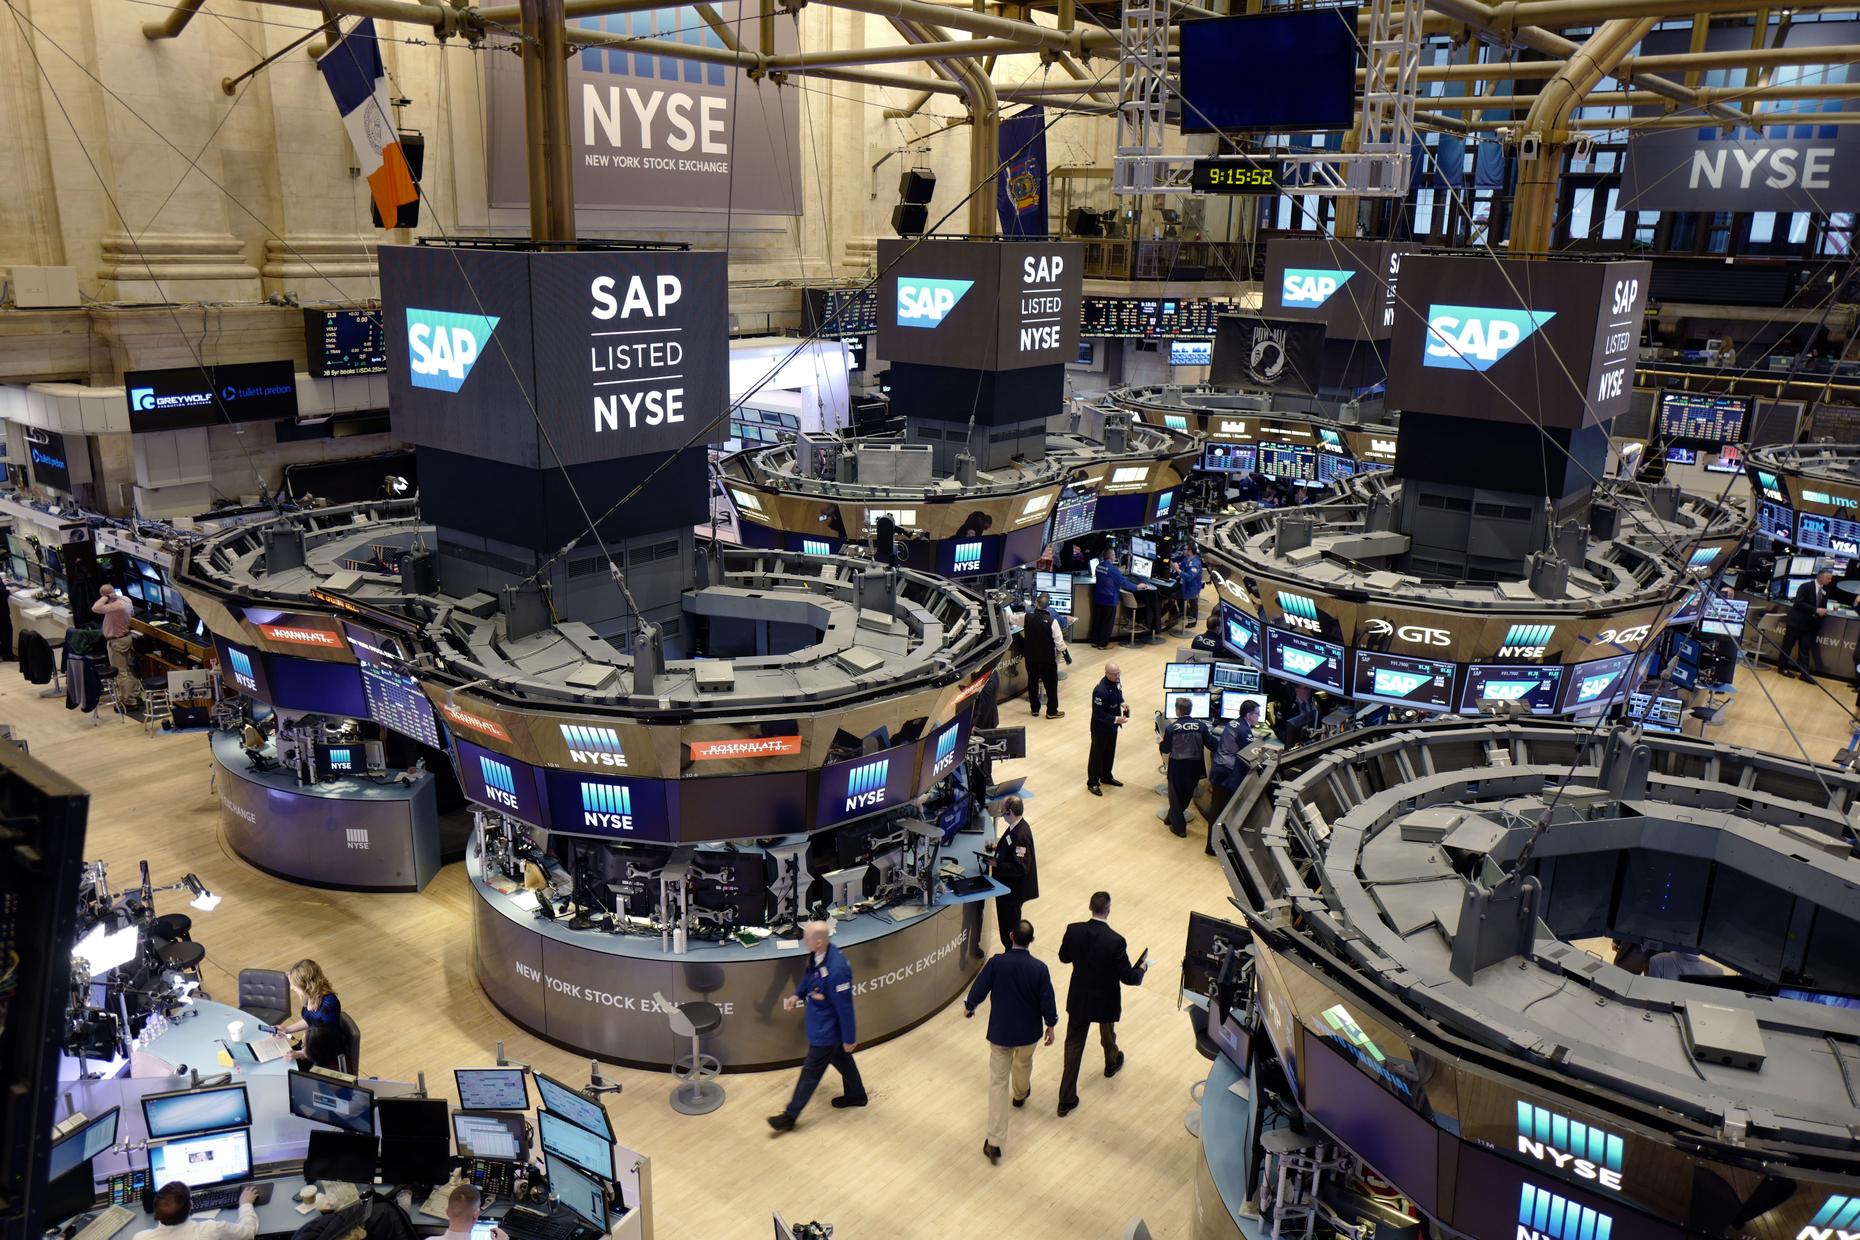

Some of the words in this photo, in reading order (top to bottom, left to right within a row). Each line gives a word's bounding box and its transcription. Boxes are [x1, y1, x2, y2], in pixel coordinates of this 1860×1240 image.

[583, 84, 728, 154] NYSE
[585, 155, 609, 167] NEW
[613, 156, 640, 168] YORK
[644, 158, 676, 170] STOCK
[679, 160, 728, 173] EXCHANGE
[1689, 148, 1835, 189] NYSE
[1210, 169, 1273, 185] 9:15:52
[1023, 256, 1064, 283] SAP
[591, 275, 682, 320] SAP
[1284, 275, 1337, 302] SAP
[1612, 279, 1638, 315] SAP
[898, 285, 954, 320] SAP
[1021, 297, 1062, 315] LISTED
[1020, 326, 1060, 351] NYSE
[1426, 316, 1520, 361] SAP
[1605, 332, 1630, 356] LISTED
[409, 322, 477, 379] SAP
[592, 341, 683, 372] LISTED
[1598, 368, 1625, 402] NYSE
[157, 393, 212, 405] GREYWOLF
[593, 388, 684, 432] NYSE
[1832, 497, 1858, 509] imc
[1803, 520, 1825, 532] IBM
[1831, 540, 1858, 554] VISA
[953, 560, 980, 572] NYSE
[1284, 612, 1322, 633] NYSE
[1398, 625, 1451, 646] GTS
[1616, 625, 1652, 643] GTS
[1816, 635, 1840, 648] NEW
[1843, 640, 1857, 651] YO
[1284, 650, 1316, 672] SAP
[1498, 646, 1546, 657] NYSE
[235, 671, 257, 692] NYSE
[1376, 673, 1418, 694] SAP
[1484, 685, 1525, 699] SAP
[1580, 677, 1610, 698] SAP
[1182, 722, 1199, 731] GTS
[710, 741, 783, 753] ROSENBLATT
[331, 762, 352, 770] NYSE
[569, 749, 628, 767] NYSE
[933, 750, 955, 777] NYSE
[486, 784, 519, 810] NYSE
[845, 788, 886, 812] NYSE
[584, 812, 633, 830] NYSE
[347, 842, 369, 850] NYSE
[850, 982, 867, 996] RK
[870, 963, 914, 991] STOCK
[915, 928, 968, 973] EXCHANGE
[515, 961, 541, 983] NEW
[544, 976, 582, 999] YORK
[584, 989, 636, 1010] STOCK
[641, 999, 734, 1015] EXGE
[1518, 1135, 1623, 1191] NYSE
